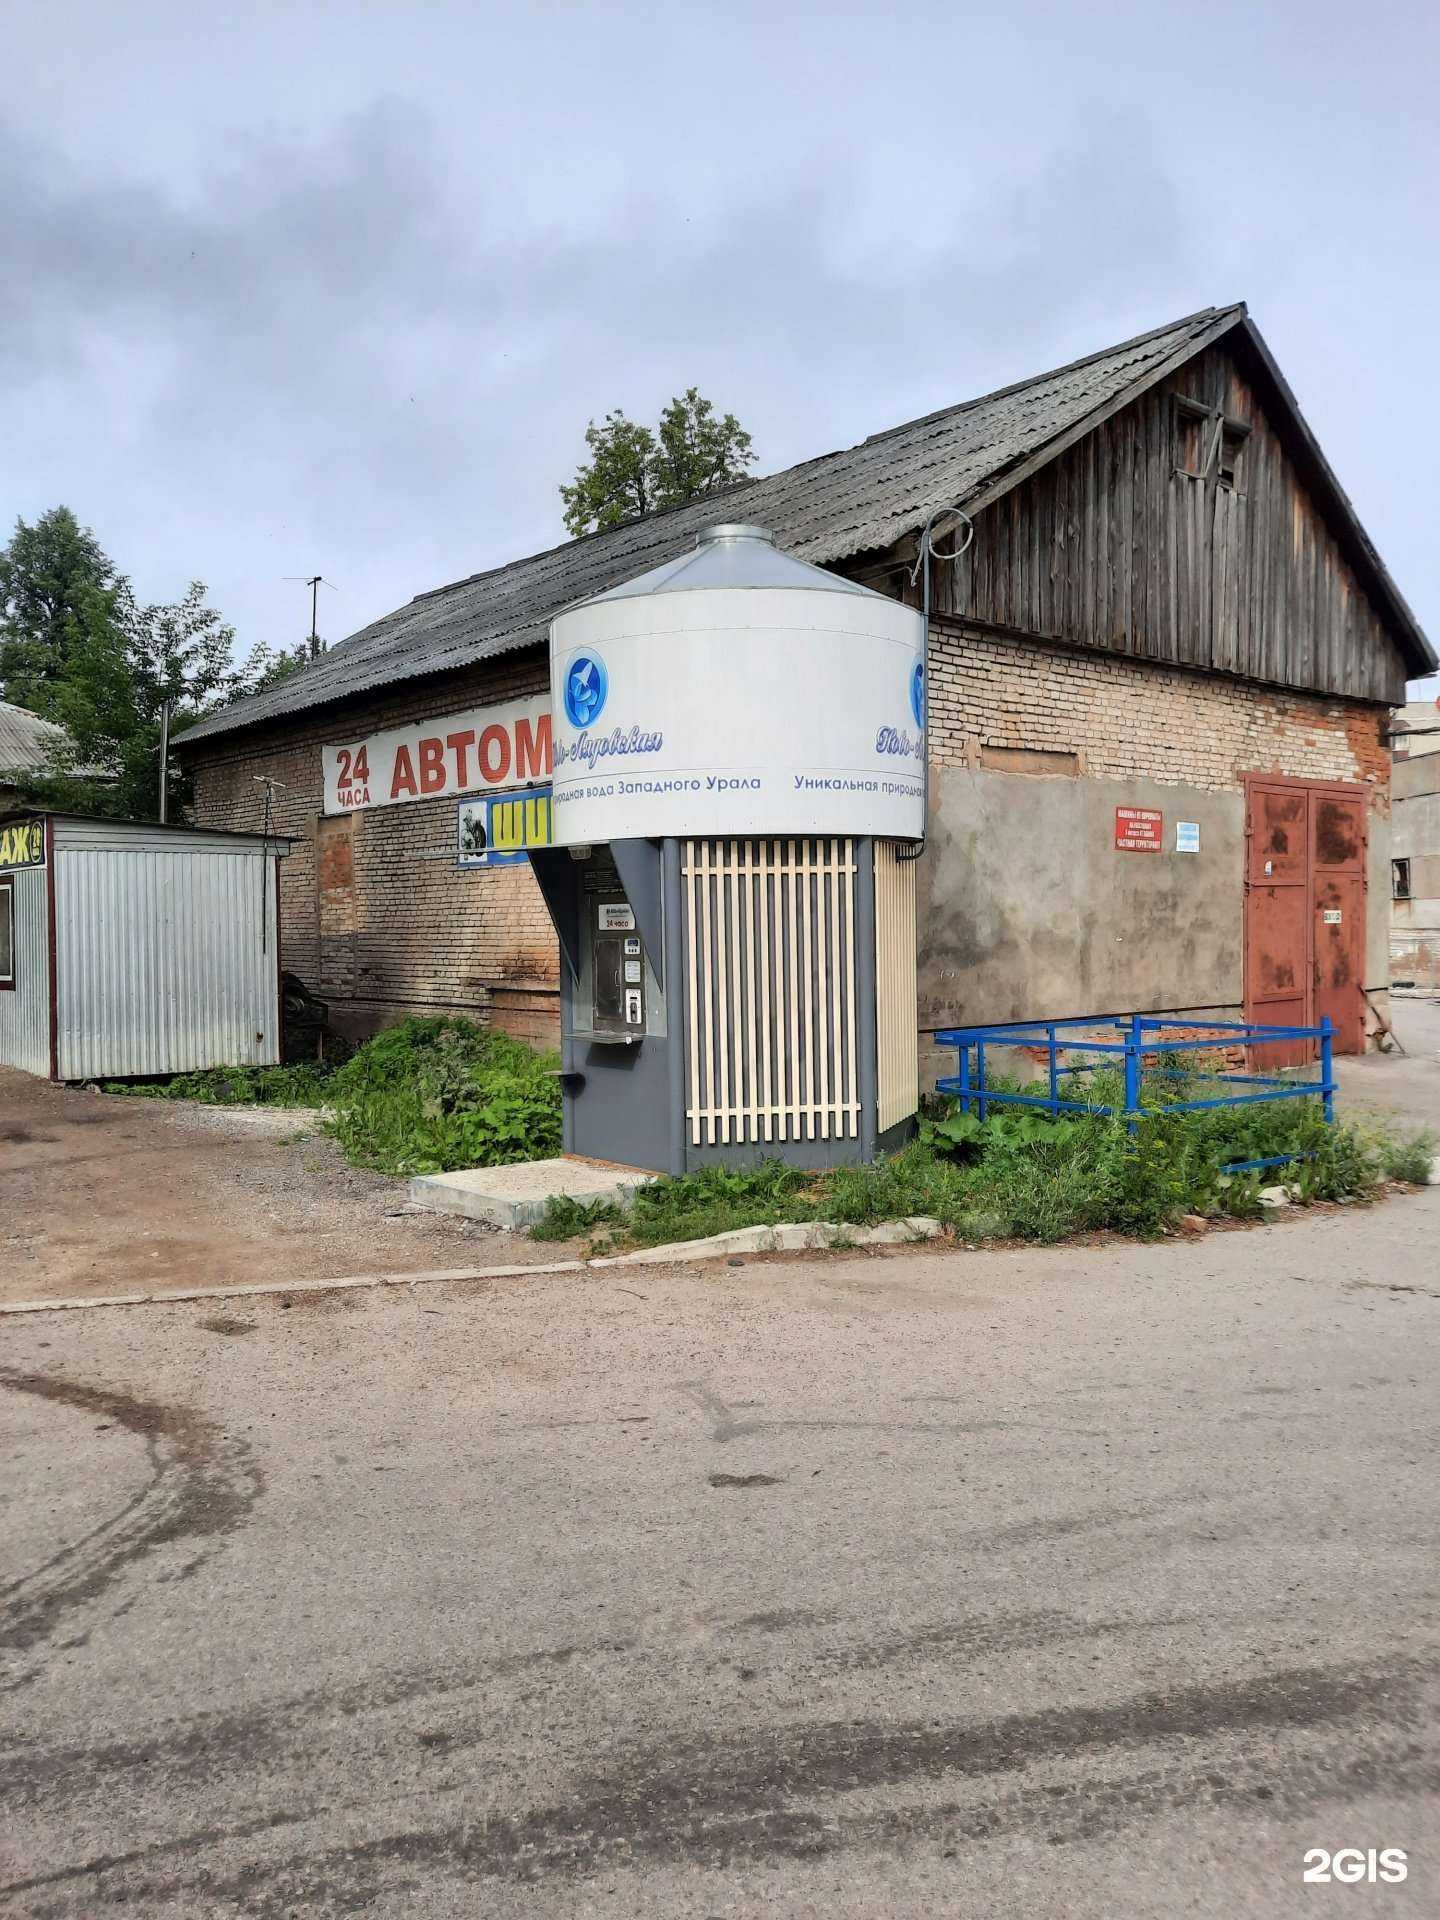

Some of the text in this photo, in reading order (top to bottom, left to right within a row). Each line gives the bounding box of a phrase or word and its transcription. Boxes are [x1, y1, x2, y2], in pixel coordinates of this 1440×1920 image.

[336, 745, 370, 789] 24
[586, 784, 614, 799] вода
[618, 780, 701, 795] Западного
[706, 776, 761, 793] Урала
[794, 776, 879, 791] Уникальная
[338, 787, 370, 808] ЧАСА
